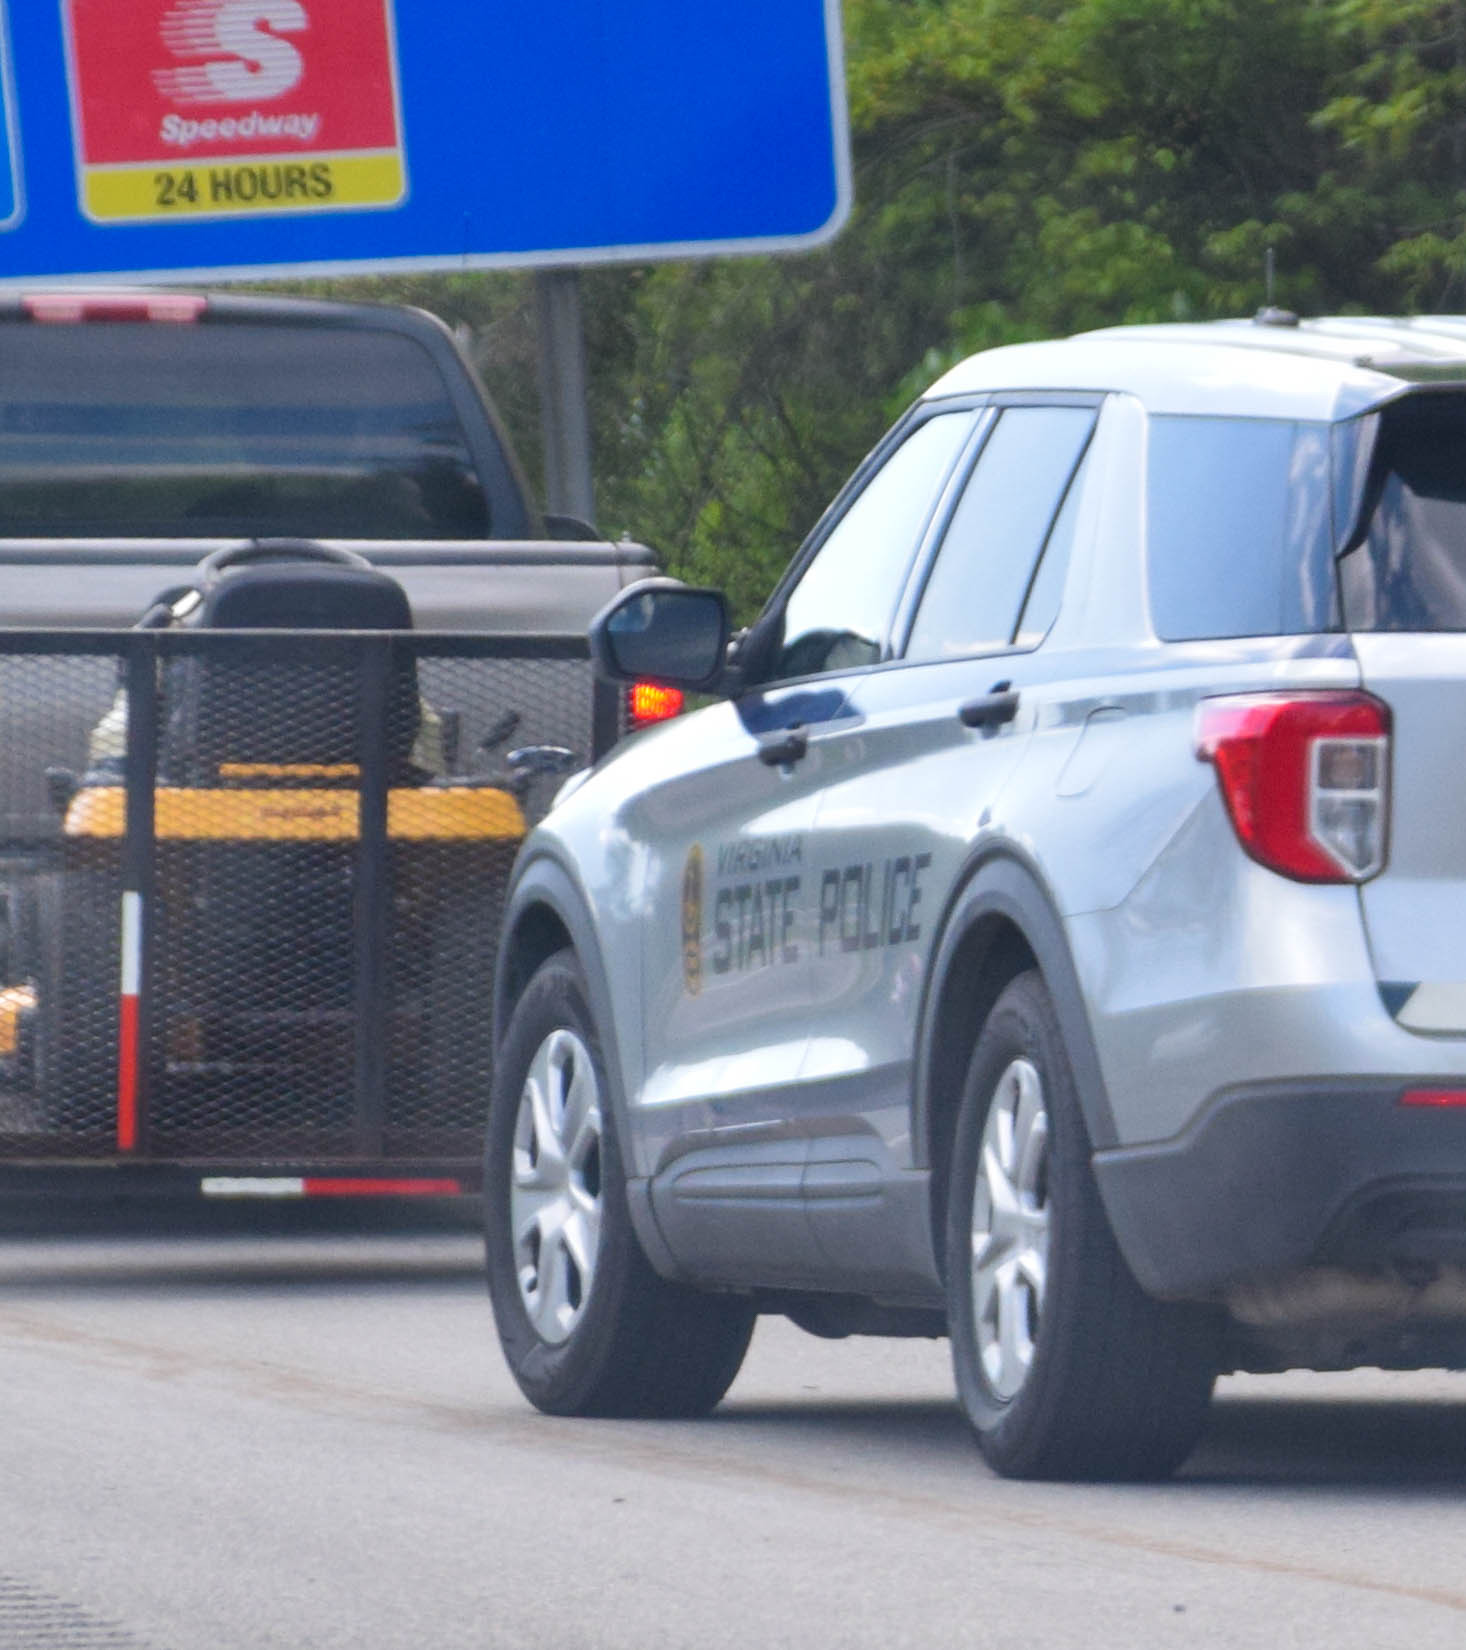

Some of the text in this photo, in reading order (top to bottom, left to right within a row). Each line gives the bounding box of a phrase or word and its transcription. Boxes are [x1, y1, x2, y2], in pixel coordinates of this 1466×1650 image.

[160, 0, 309, 103] S
[160, 111, 319, 147] Speedway
[154, 162, 333, 206] 24 HOURS
[717, 836, 802, 877] VIRGINIA
[712, 852, 933, 975] STATE POLICE
